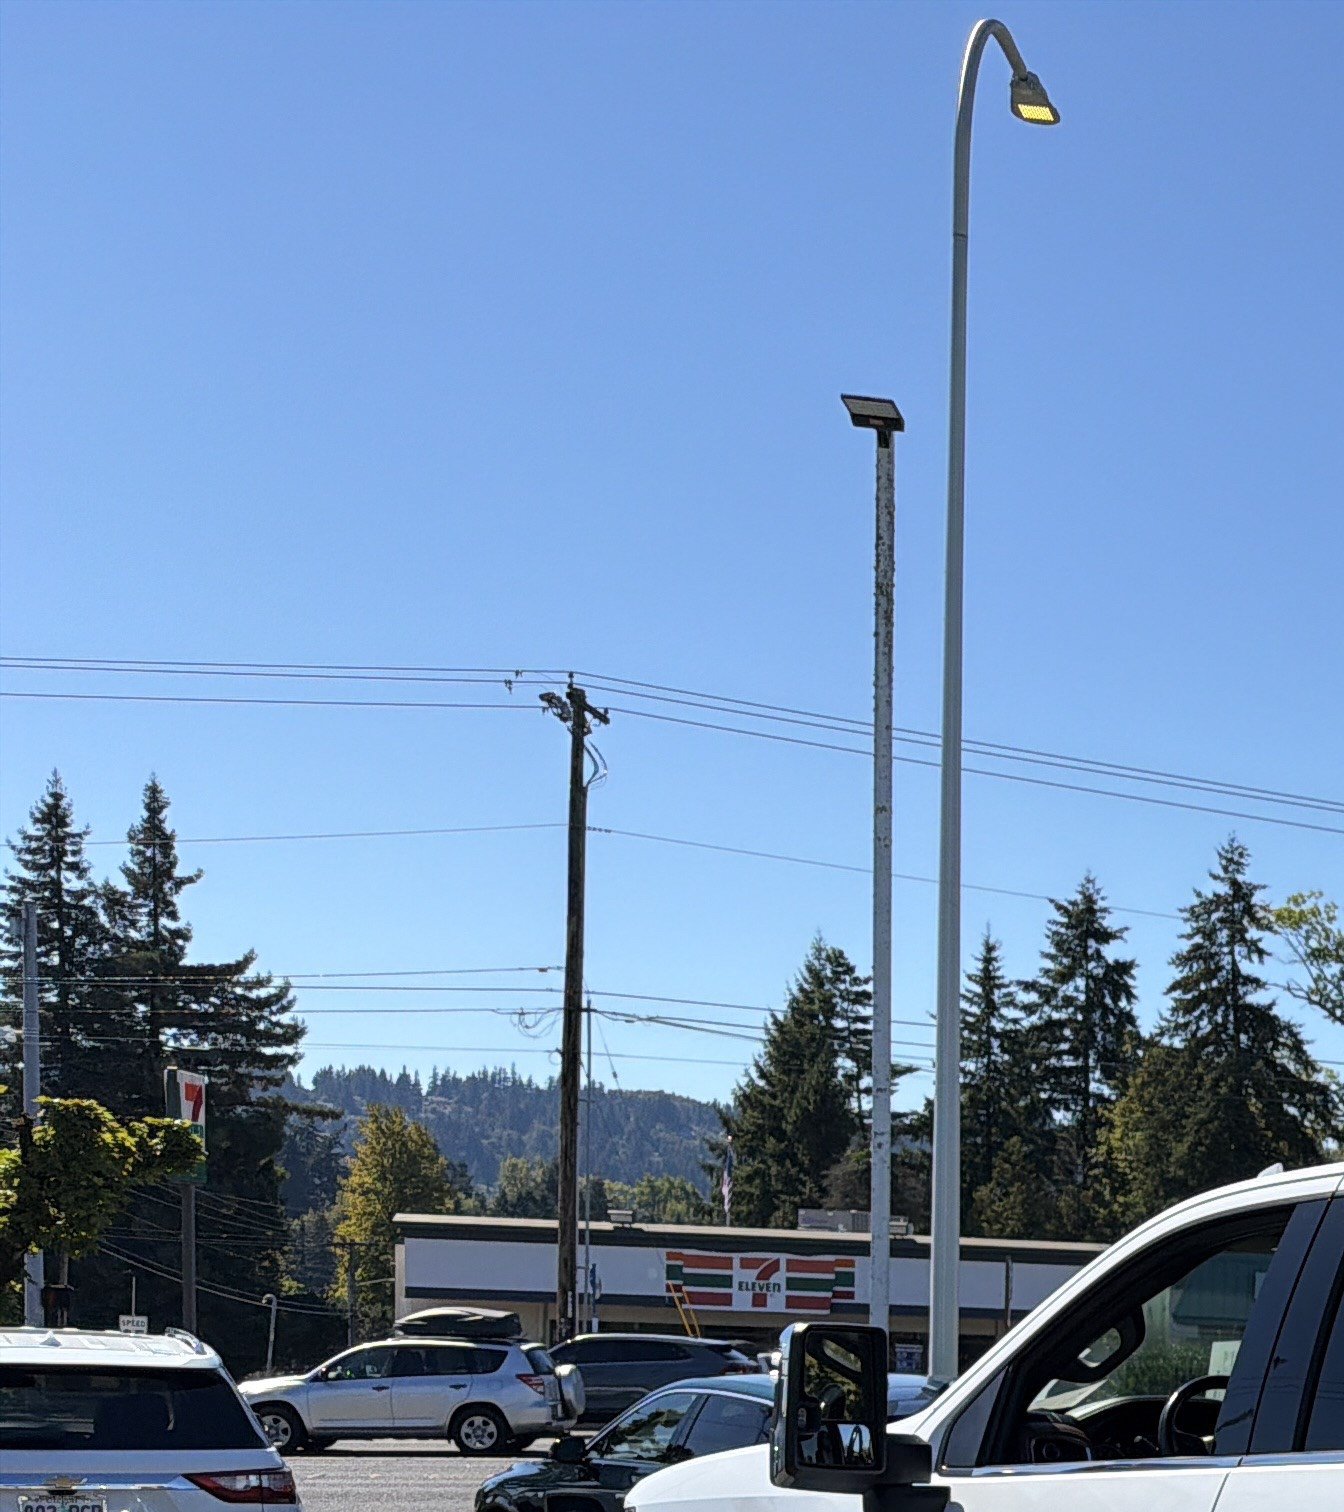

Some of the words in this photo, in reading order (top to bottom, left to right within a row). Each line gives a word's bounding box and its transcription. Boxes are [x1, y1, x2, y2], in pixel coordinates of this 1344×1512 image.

[184, 1082, 203, 1122] 7
[739, 1257, 780, 1308] 7
[121, 1319, 146, 1328] SPEED
